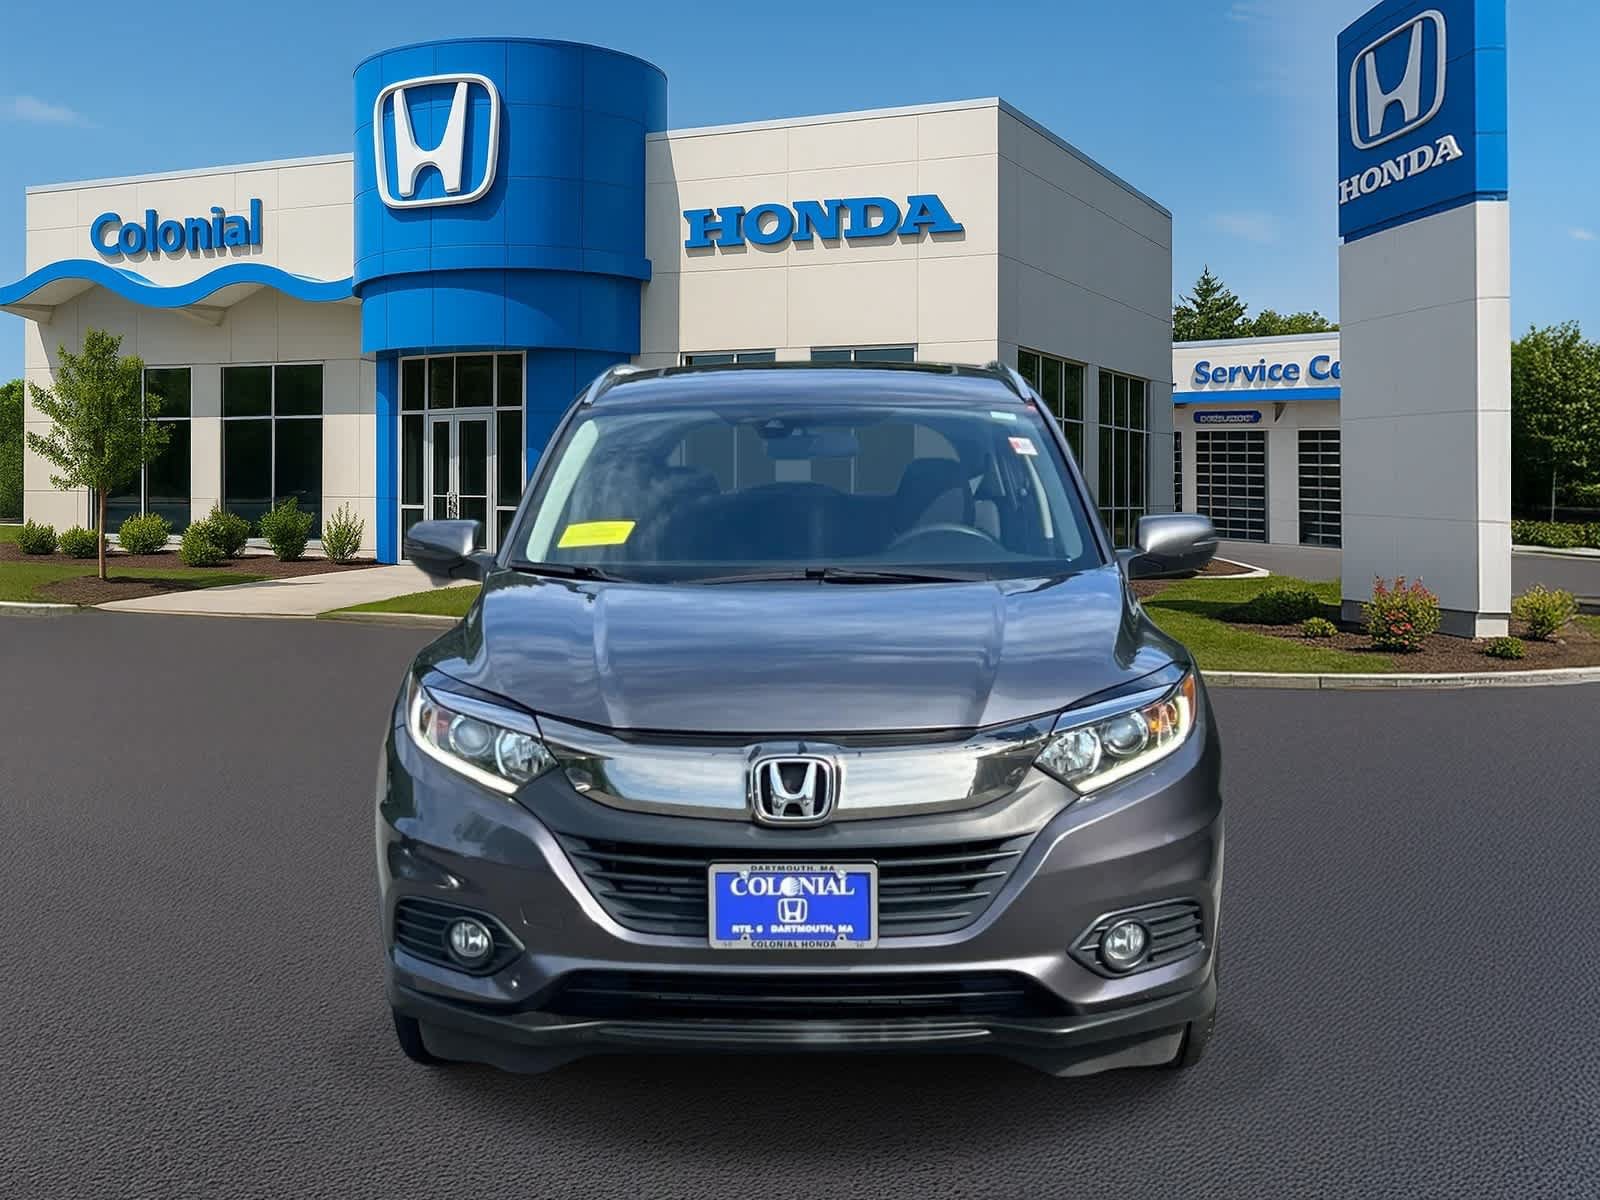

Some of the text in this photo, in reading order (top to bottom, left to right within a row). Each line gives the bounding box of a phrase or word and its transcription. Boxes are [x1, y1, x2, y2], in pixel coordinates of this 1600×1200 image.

[1339, 134, 1463, 204] HONDA
[90, 198, 263, 256] Colonial
[683, 194, 966, 249] HONDA
[1194, 358, 1300, 384] Service
[730, 876, 855, 897] COLONIAL
[770, 924, 836, 935] DARTMOUTH,
[838, 924, 854, 934] MA
[751, 940, 837, 949] COLONIAL HONDA
